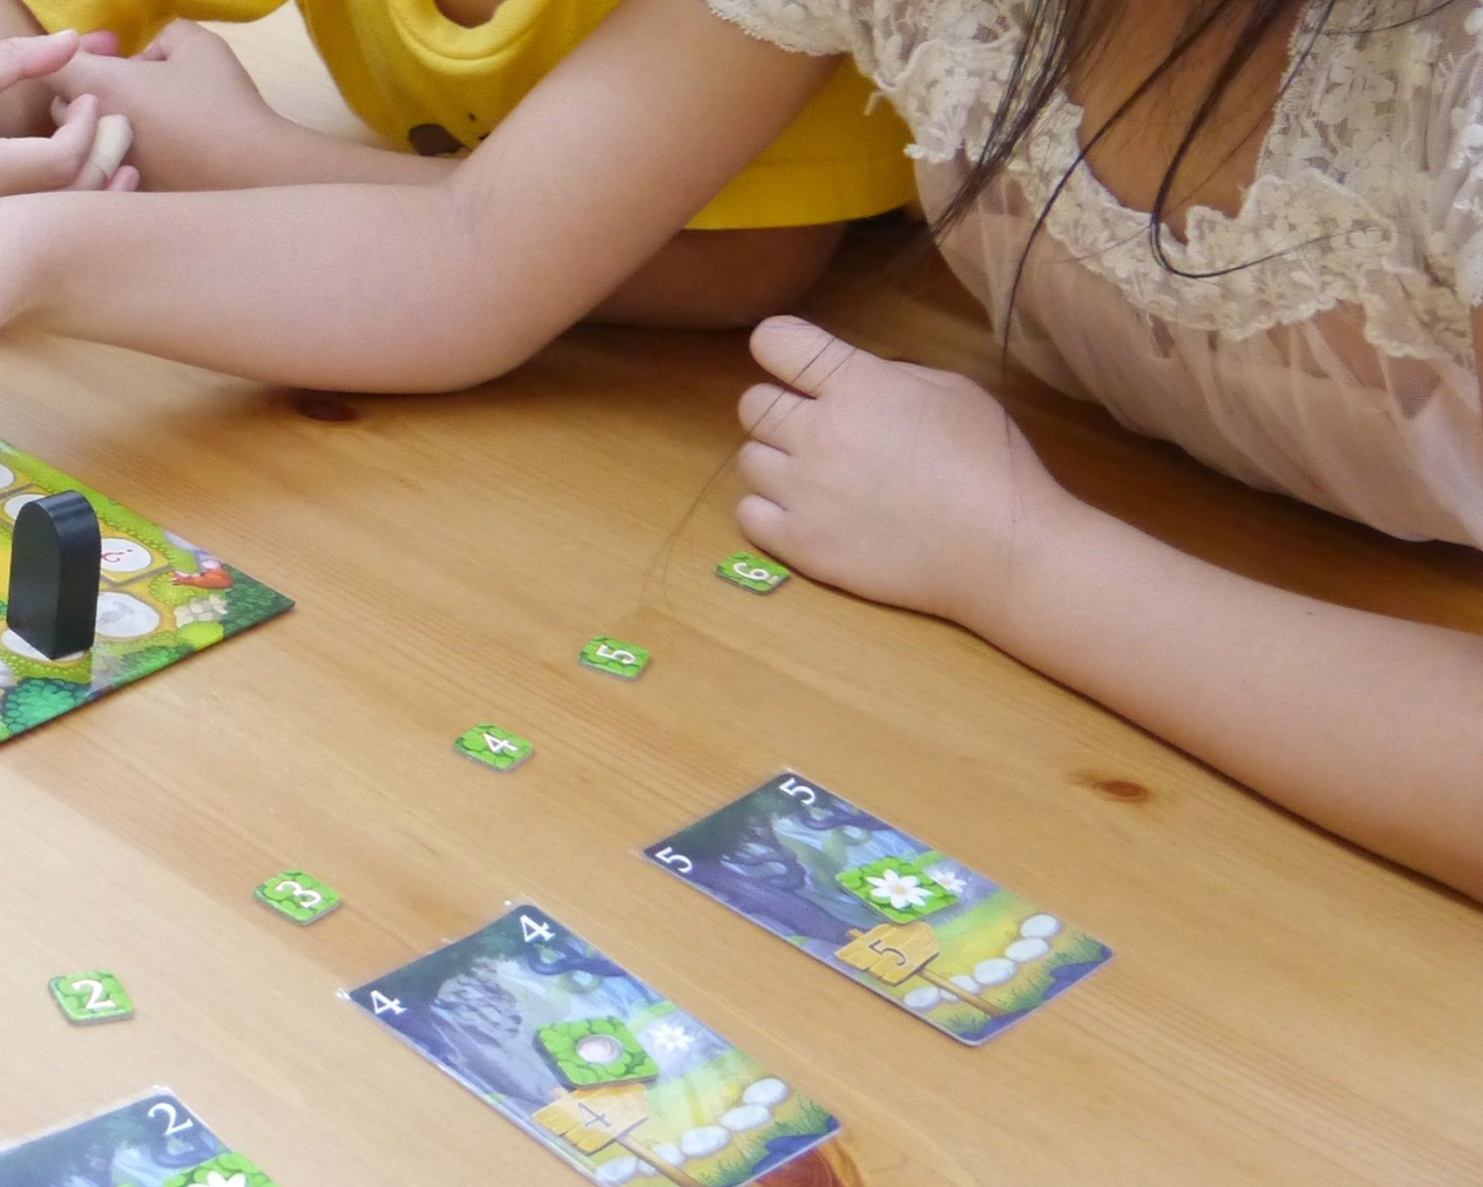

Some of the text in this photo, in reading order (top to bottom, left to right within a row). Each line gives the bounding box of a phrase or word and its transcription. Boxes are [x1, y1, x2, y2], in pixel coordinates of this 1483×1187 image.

[733, 562, 773, 582] 6
[596, 644, 637, 666] 5
[482, 732, 519, 754] 4
[779, 777, 816, 805] 5
[654, 845, 694, 874] 5
[275, 880, 322, 910] 3
[519, 914, 556, 942] 4
[868, 938, 906, 967] 5
[71, 979, 116, 1010] 2
[369, 989, 407, 1016] 4
[147, 1102, 194, 1136] 2
[577, 1101, 612, 1128] 4
